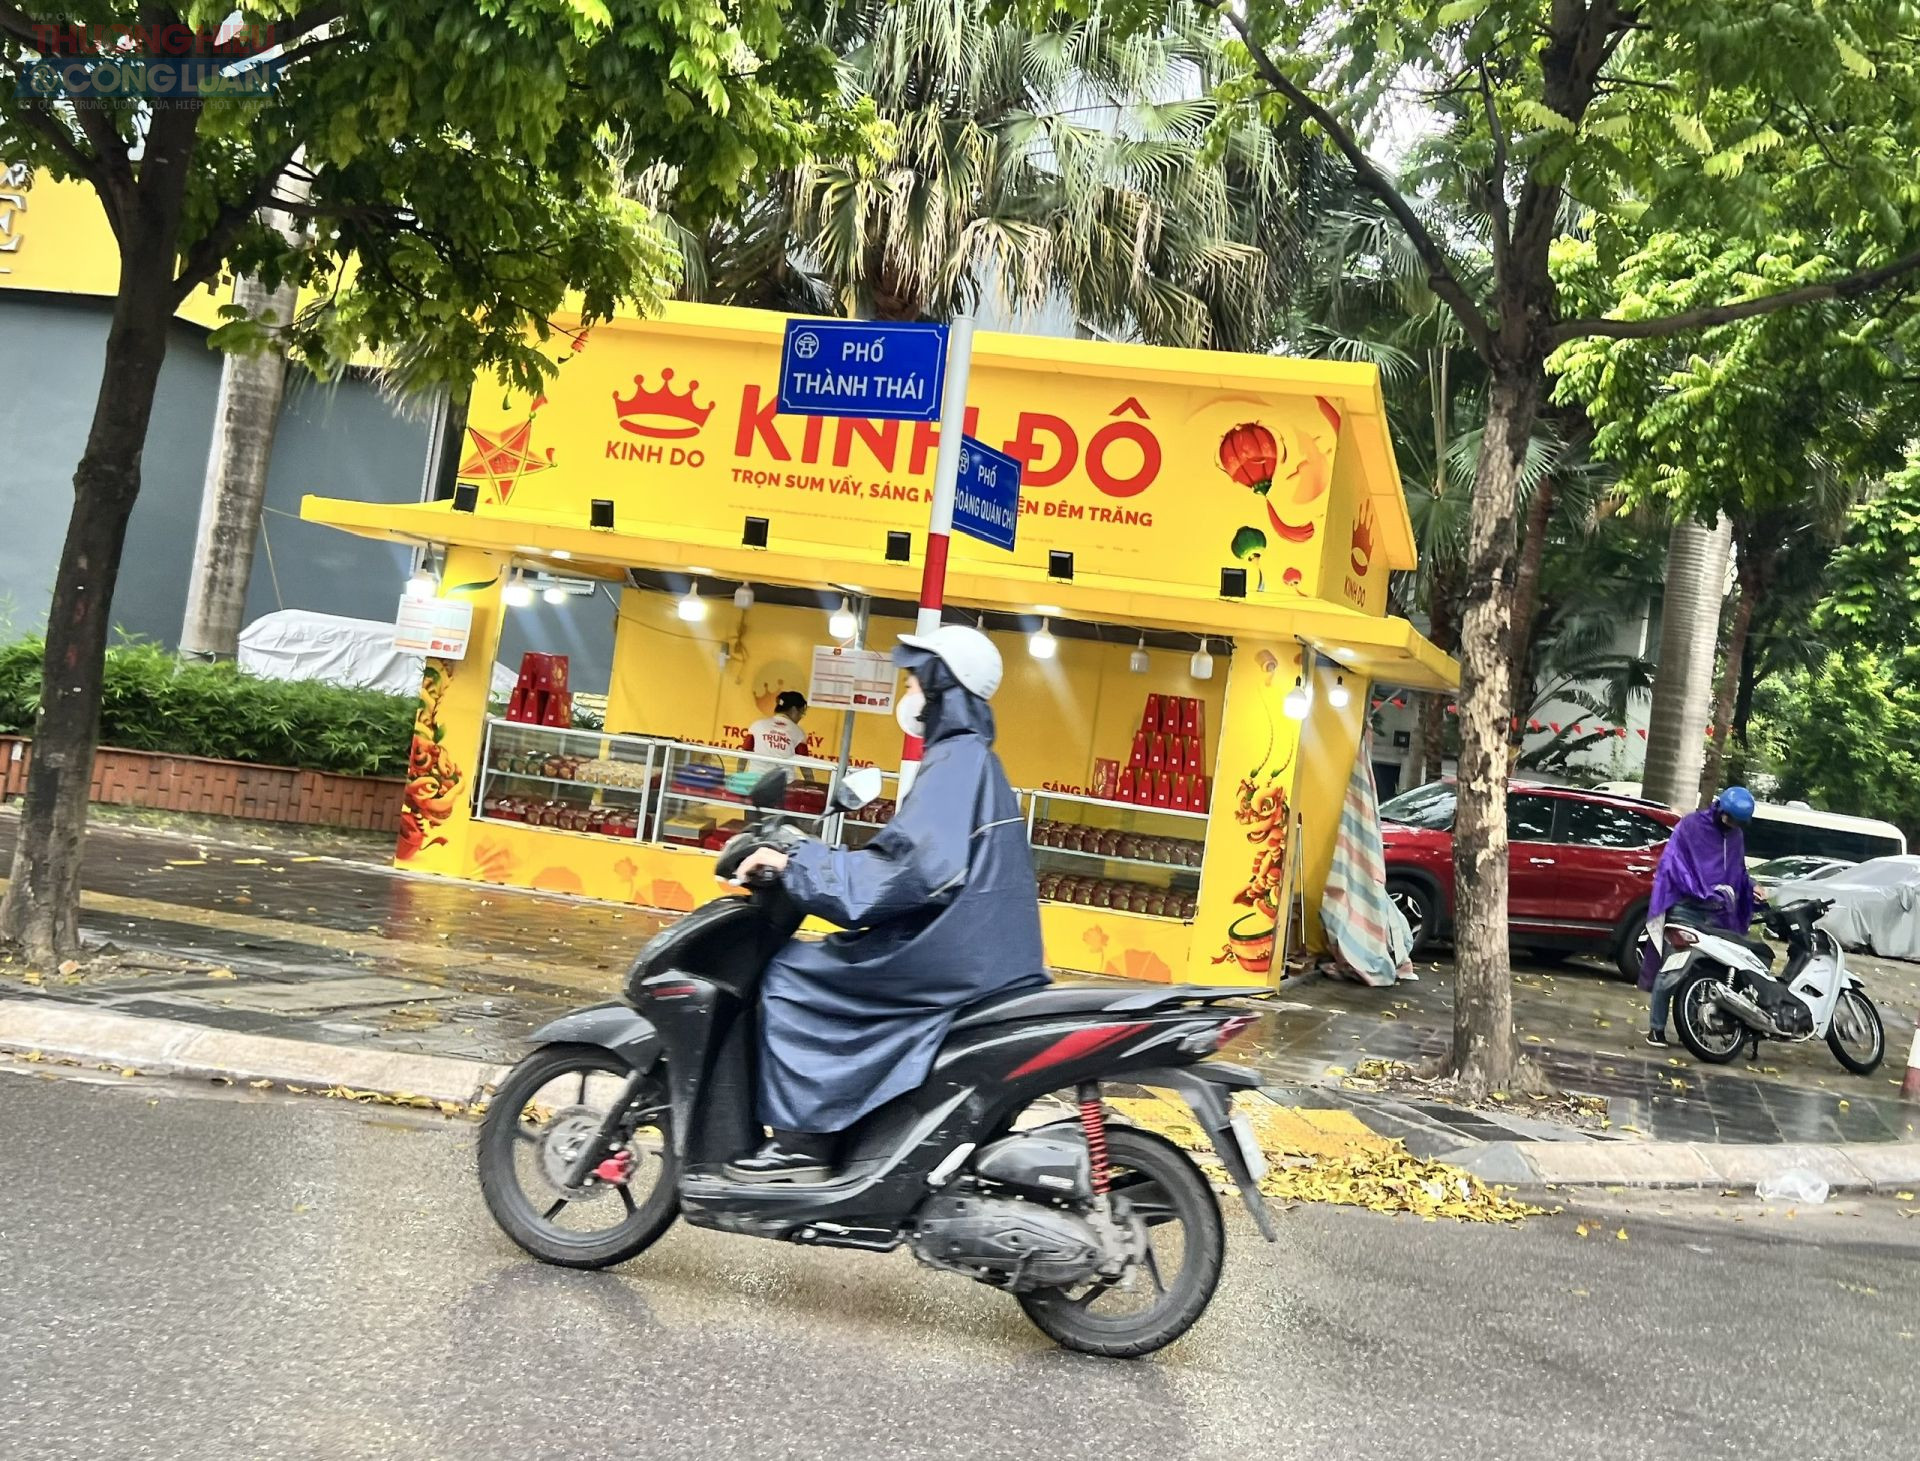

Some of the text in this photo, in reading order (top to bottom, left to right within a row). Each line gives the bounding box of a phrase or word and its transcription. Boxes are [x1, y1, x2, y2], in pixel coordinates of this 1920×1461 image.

[842, 336, 886, 363] PHỐ
[793, 368, 925, 400] THÀNH THÁI
[605, 440, 705, 468] KINH DO
[1002, 397, 1161, 498] ĐÔ
[731, 468, 781, 488] TRỌN
[784, 474, 825, 492] SUM
[869, 480, 919, 502] SÁNG
[978, 465, 998, 488] PHỐ
[980, 498, 1002, 526] QUÁN
[1044, 499, 1084, 520] ĐÊM
[1088, 505, 1153, 527] TRĂNG
[769, 741, 787, 751] THU
